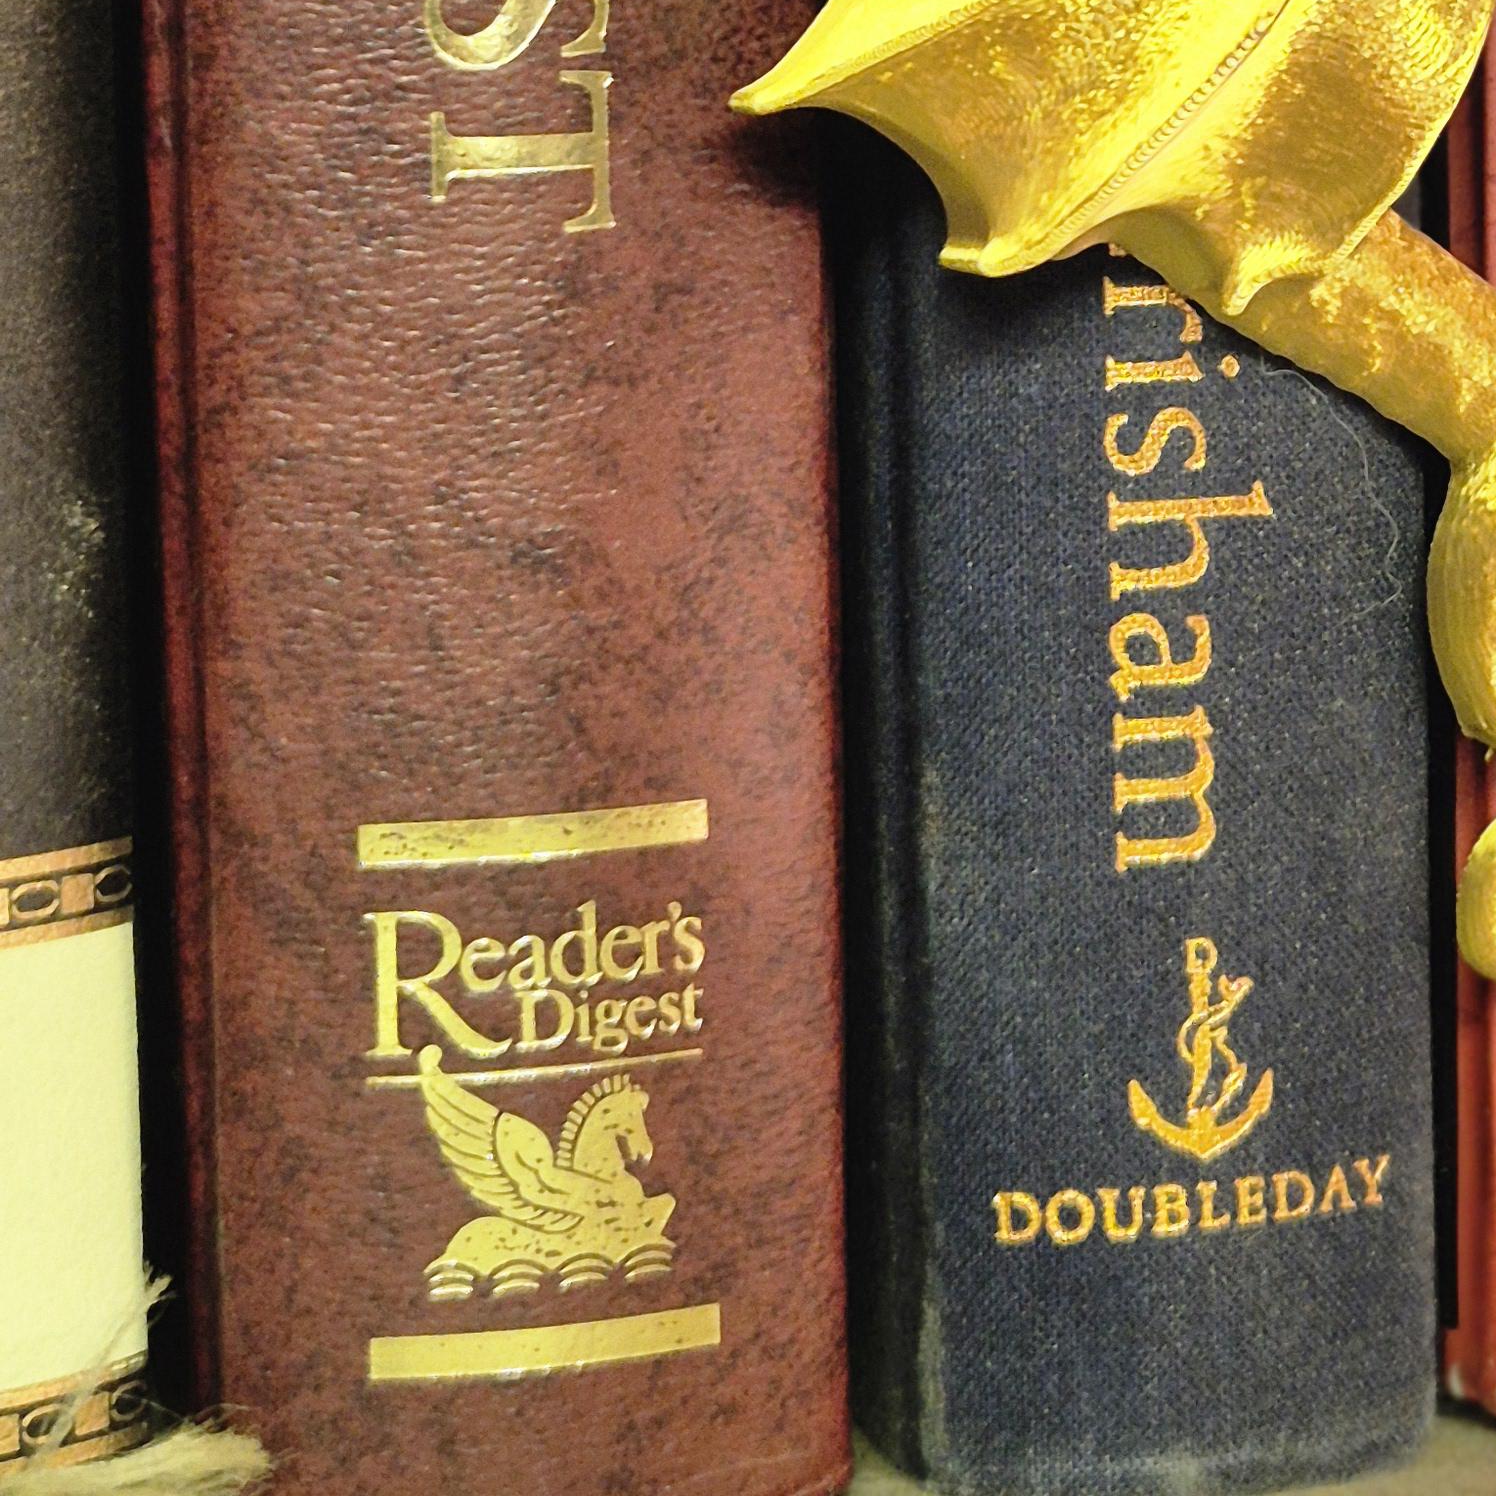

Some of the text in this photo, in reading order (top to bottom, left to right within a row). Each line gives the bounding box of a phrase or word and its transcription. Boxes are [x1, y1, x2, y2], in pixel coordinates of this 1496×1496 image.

[1103, 244, 1274, 872] risham
[361, 900, 707, 1059] Reader's
[508, 983, 705, 1055] Digest
[992, 1153, 1391, 1246] DOUBLEDAY
